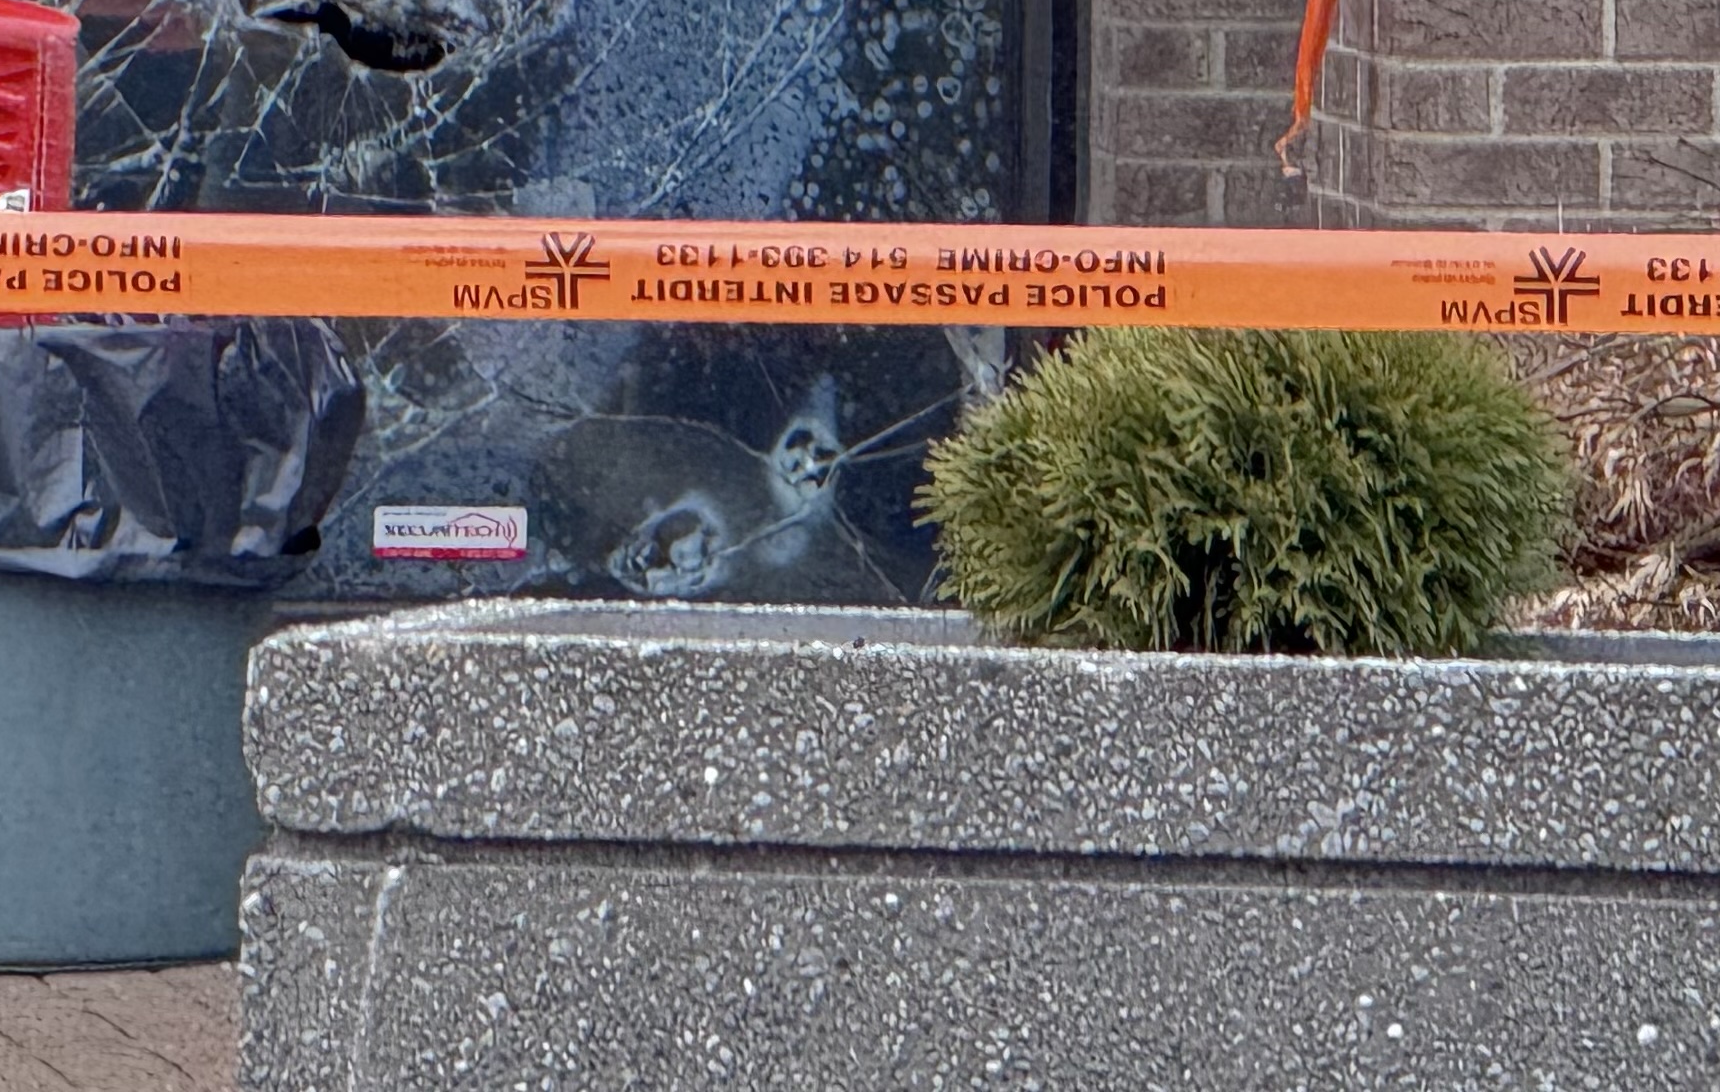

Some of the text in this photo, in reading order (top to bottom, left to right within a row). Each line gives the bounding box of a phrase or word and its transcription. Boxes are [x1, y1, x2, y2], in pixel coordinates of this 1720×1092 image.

[844, 247, 908, 270] 514
[936, 249, 1165, 275] INFO-CRIME
[42, 269, 181, 293] POLICE
[453, 284, 552, 309] SPVM
[631, 279, 1166, 309] POLICE PASSAGE INTERDIT
[1441, 300, 1541, 325] SPVM
